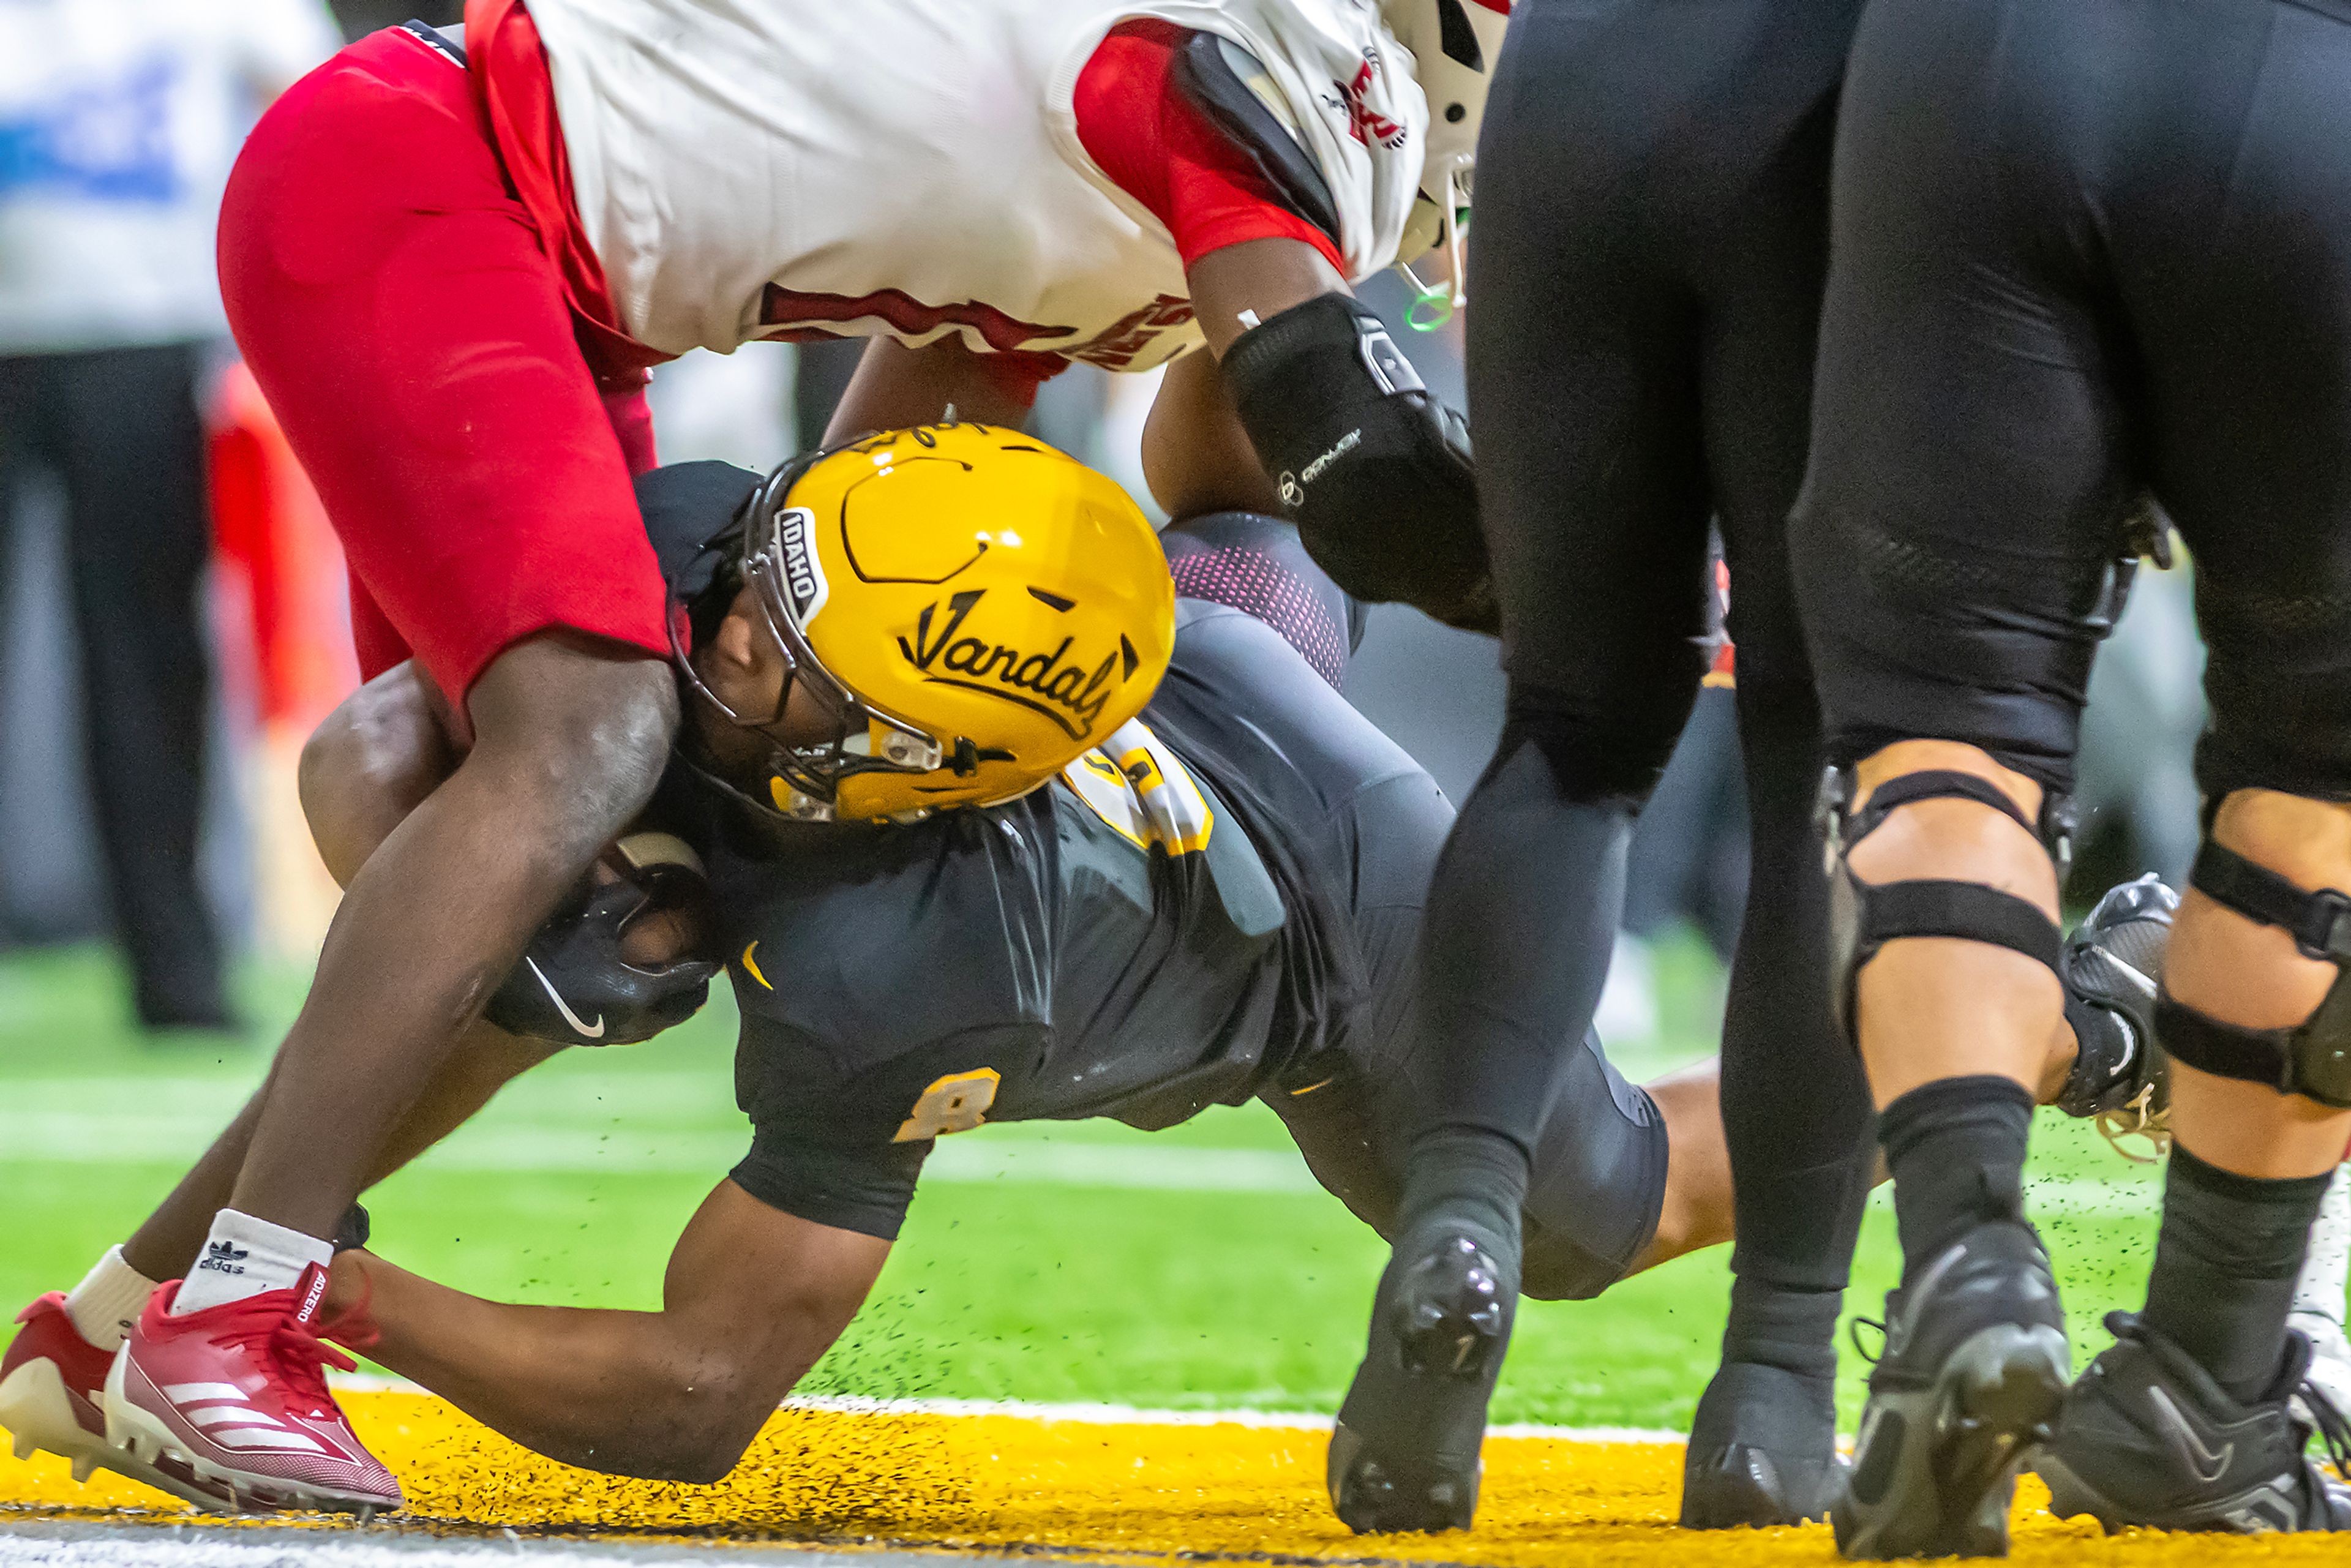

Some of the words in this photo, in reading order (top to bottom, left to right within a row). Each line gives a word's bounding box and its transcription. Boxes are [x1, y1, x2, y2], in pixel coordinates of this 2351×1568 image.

[782, 514, 816, 599] IDAHO
[912, 588, 1119, 740] Vandals
[298, 1270, 327, 1323] ADIZERO
